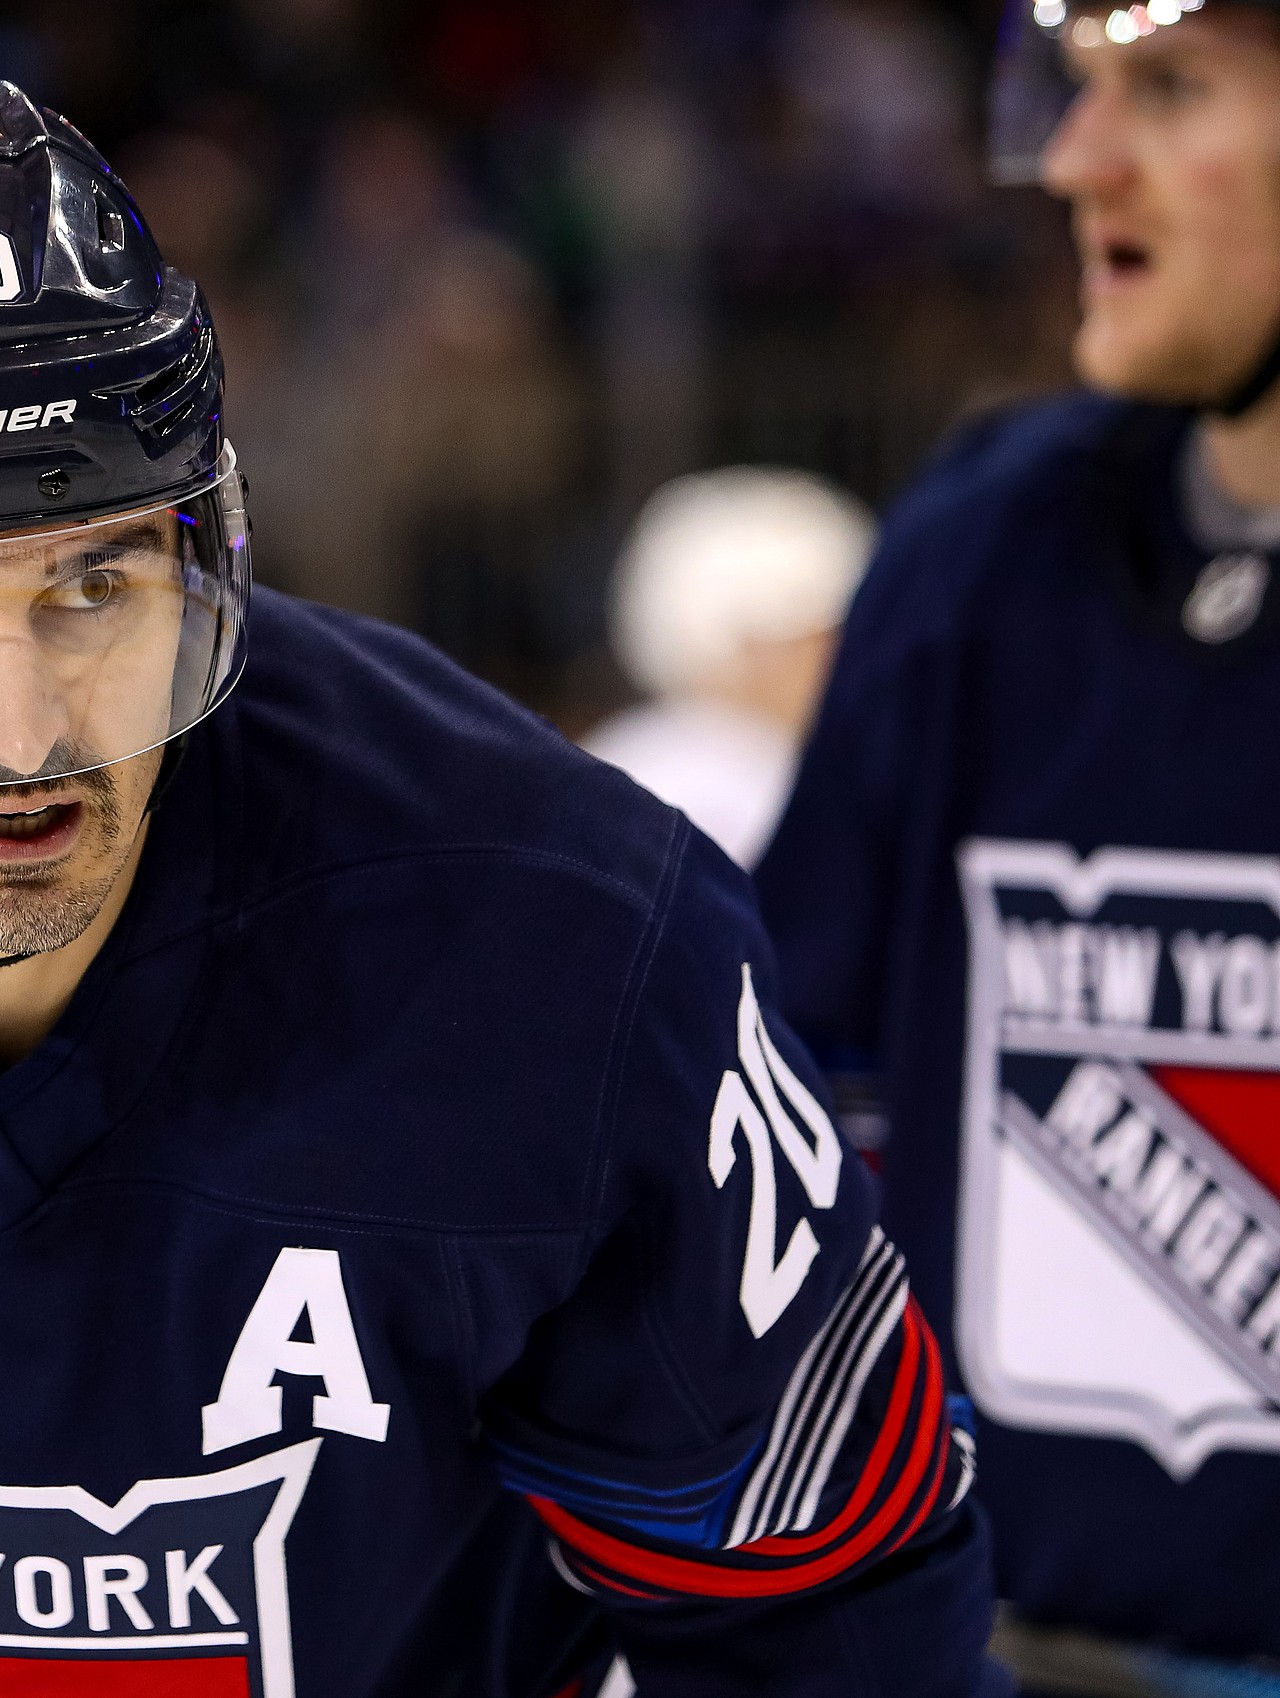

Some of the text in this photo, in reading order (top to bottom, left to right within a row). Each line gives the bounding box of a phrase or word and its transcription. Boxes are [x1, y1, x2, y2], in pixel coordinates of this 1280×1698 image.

[1002, 918, 1280, 1042] NEW YO
[707, 962, 843, 1340] 20
[201, 1245, 391, 1456] A
